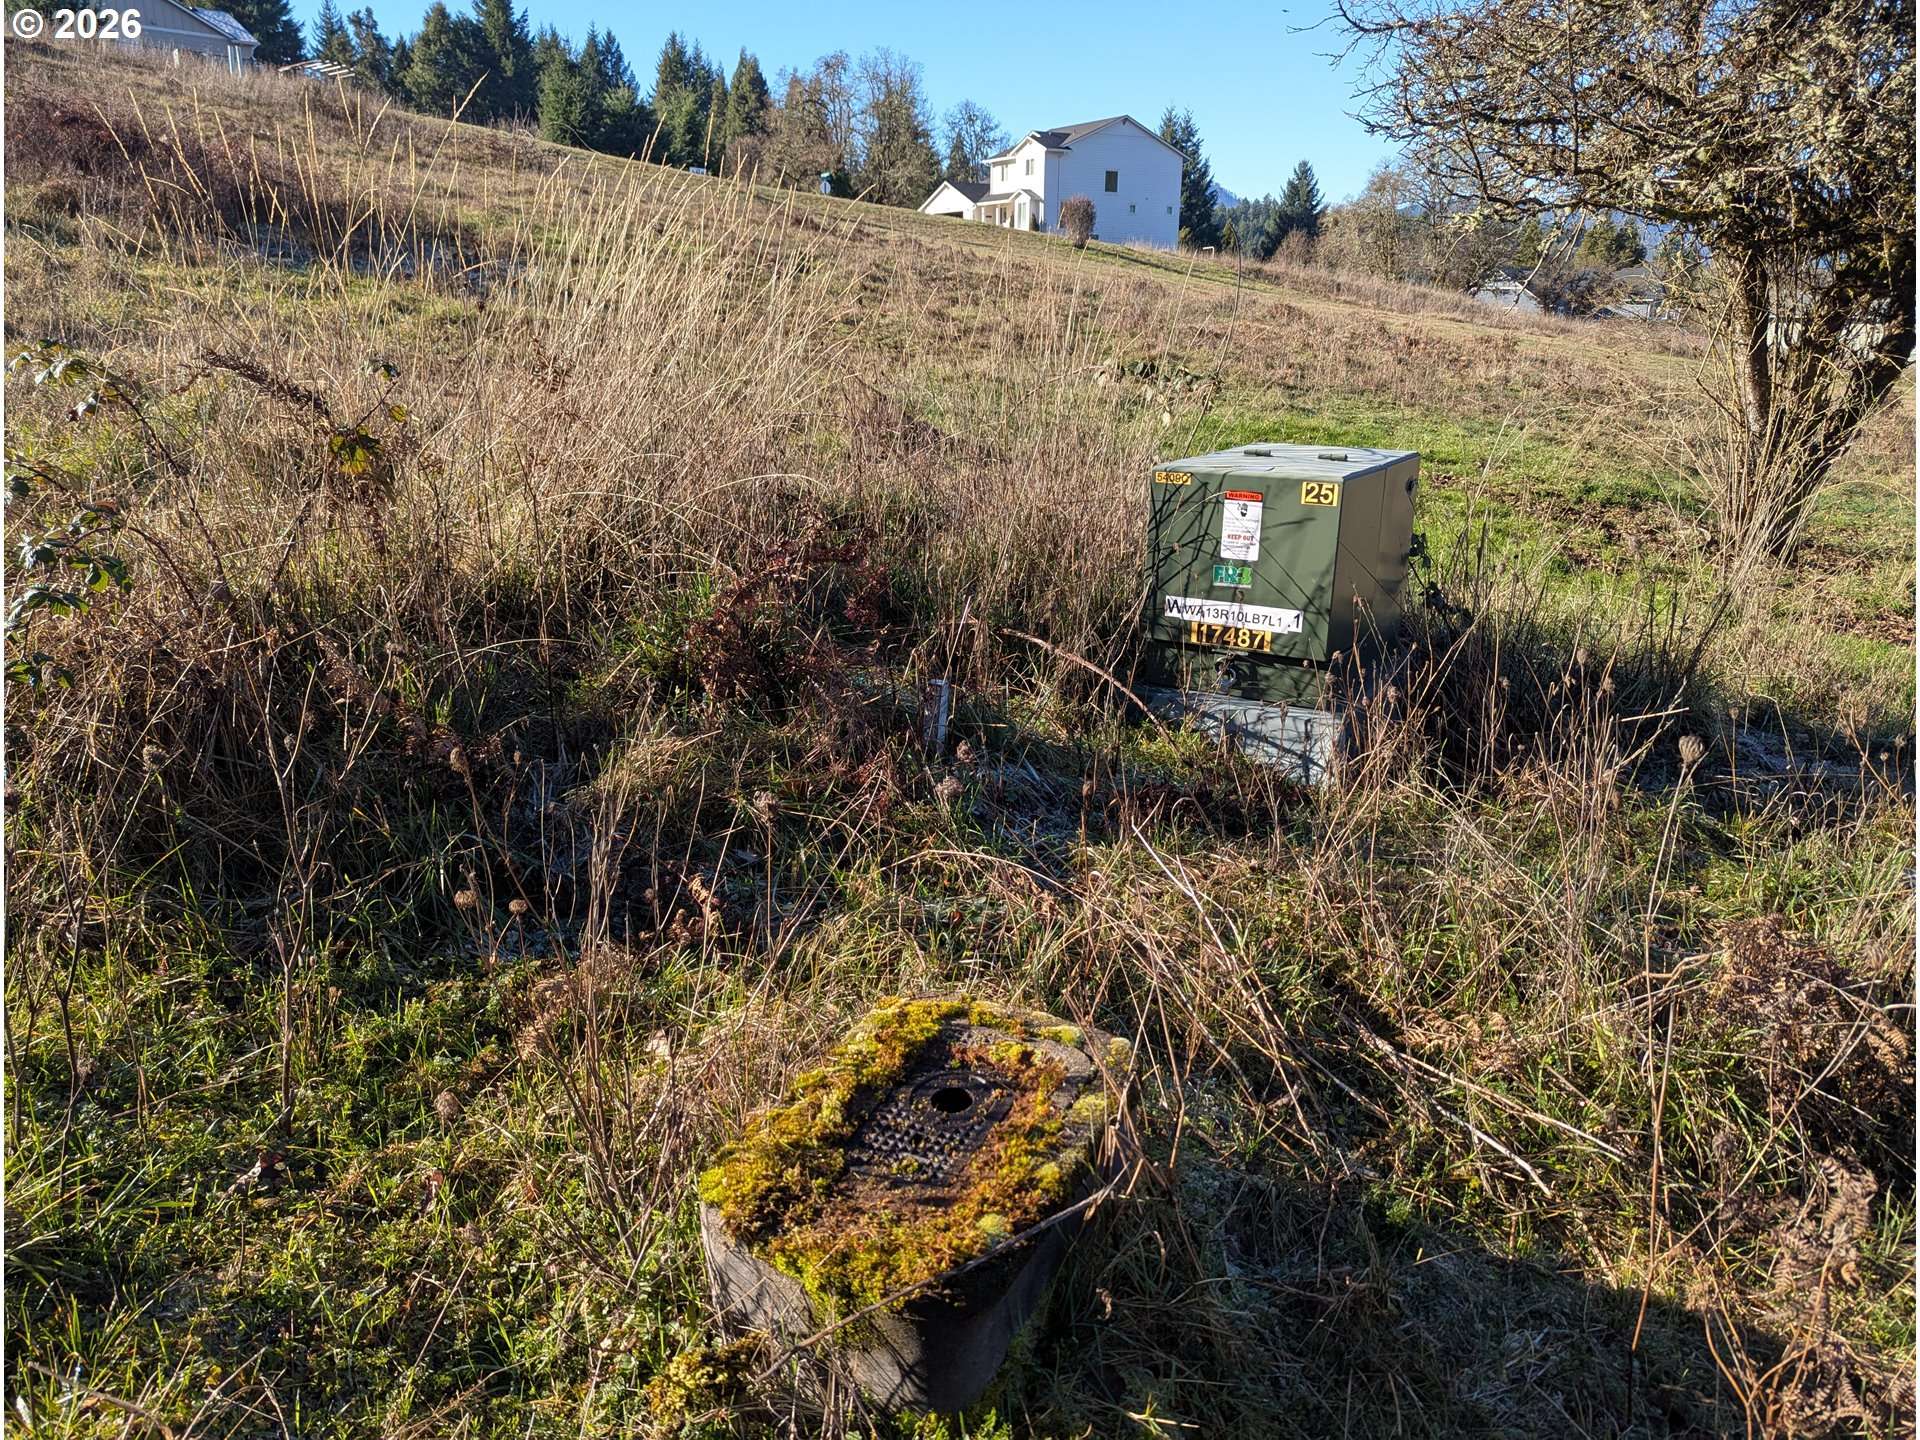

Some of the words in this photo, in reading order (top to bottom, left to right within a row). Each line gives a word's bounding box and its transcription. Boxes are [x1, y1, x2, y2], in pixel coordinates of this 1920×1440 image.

[1228, 492, 1261, 500] WARNING
[1305, 482, 1333, 504] 25
[1200, 623, 1265, 649] 17487
